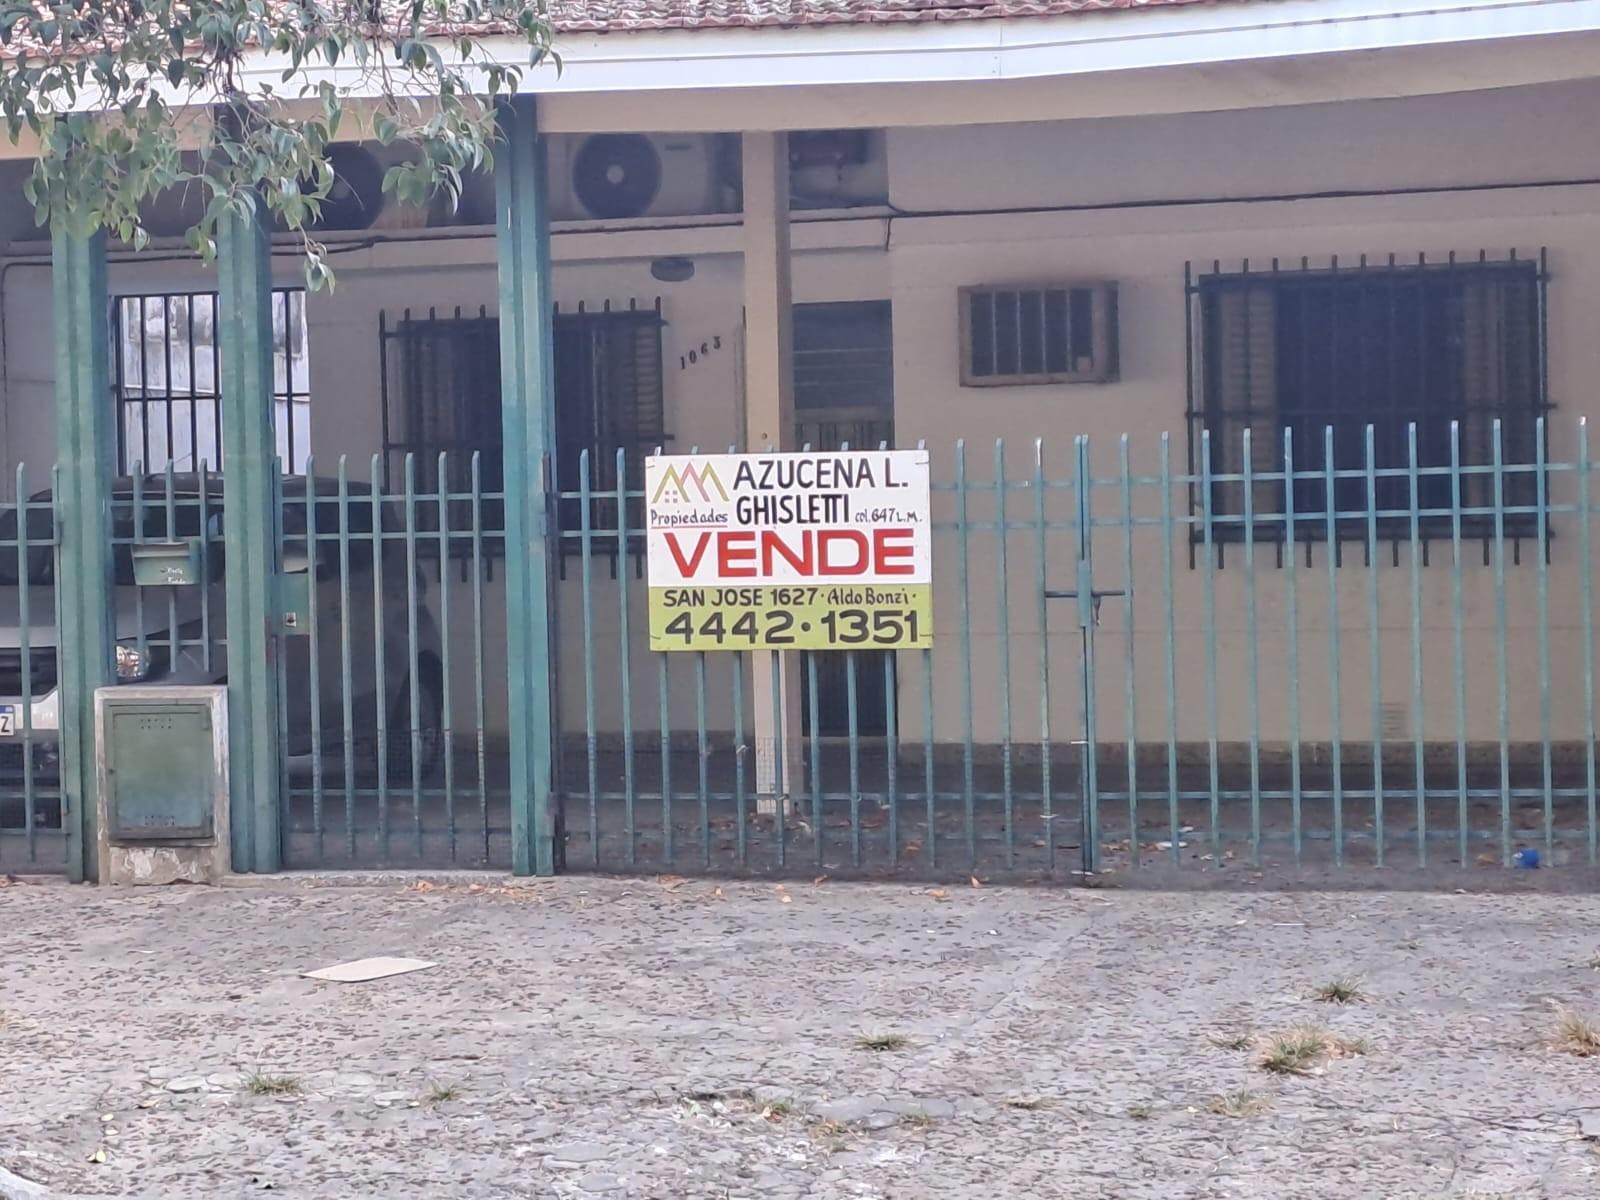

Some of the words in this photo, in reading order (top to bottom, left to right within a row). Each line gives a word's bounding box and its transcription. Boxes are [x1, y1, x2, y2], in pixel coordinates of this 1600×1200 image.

[733, 457, 875, 491] AZUCENA
[885, 457, 908, 488] L.
[650, 509, 729, 526] Propiedades
[736, 494, 849, 526] GHISLETTI
[663, 527, 915, 578] VENDE
[663, 589, 705, 607] SAN
[711, 588, 763, 607] JOSE
[770, 587, 818, 606] 1627
[827, 587, 863, 605] Aldo
